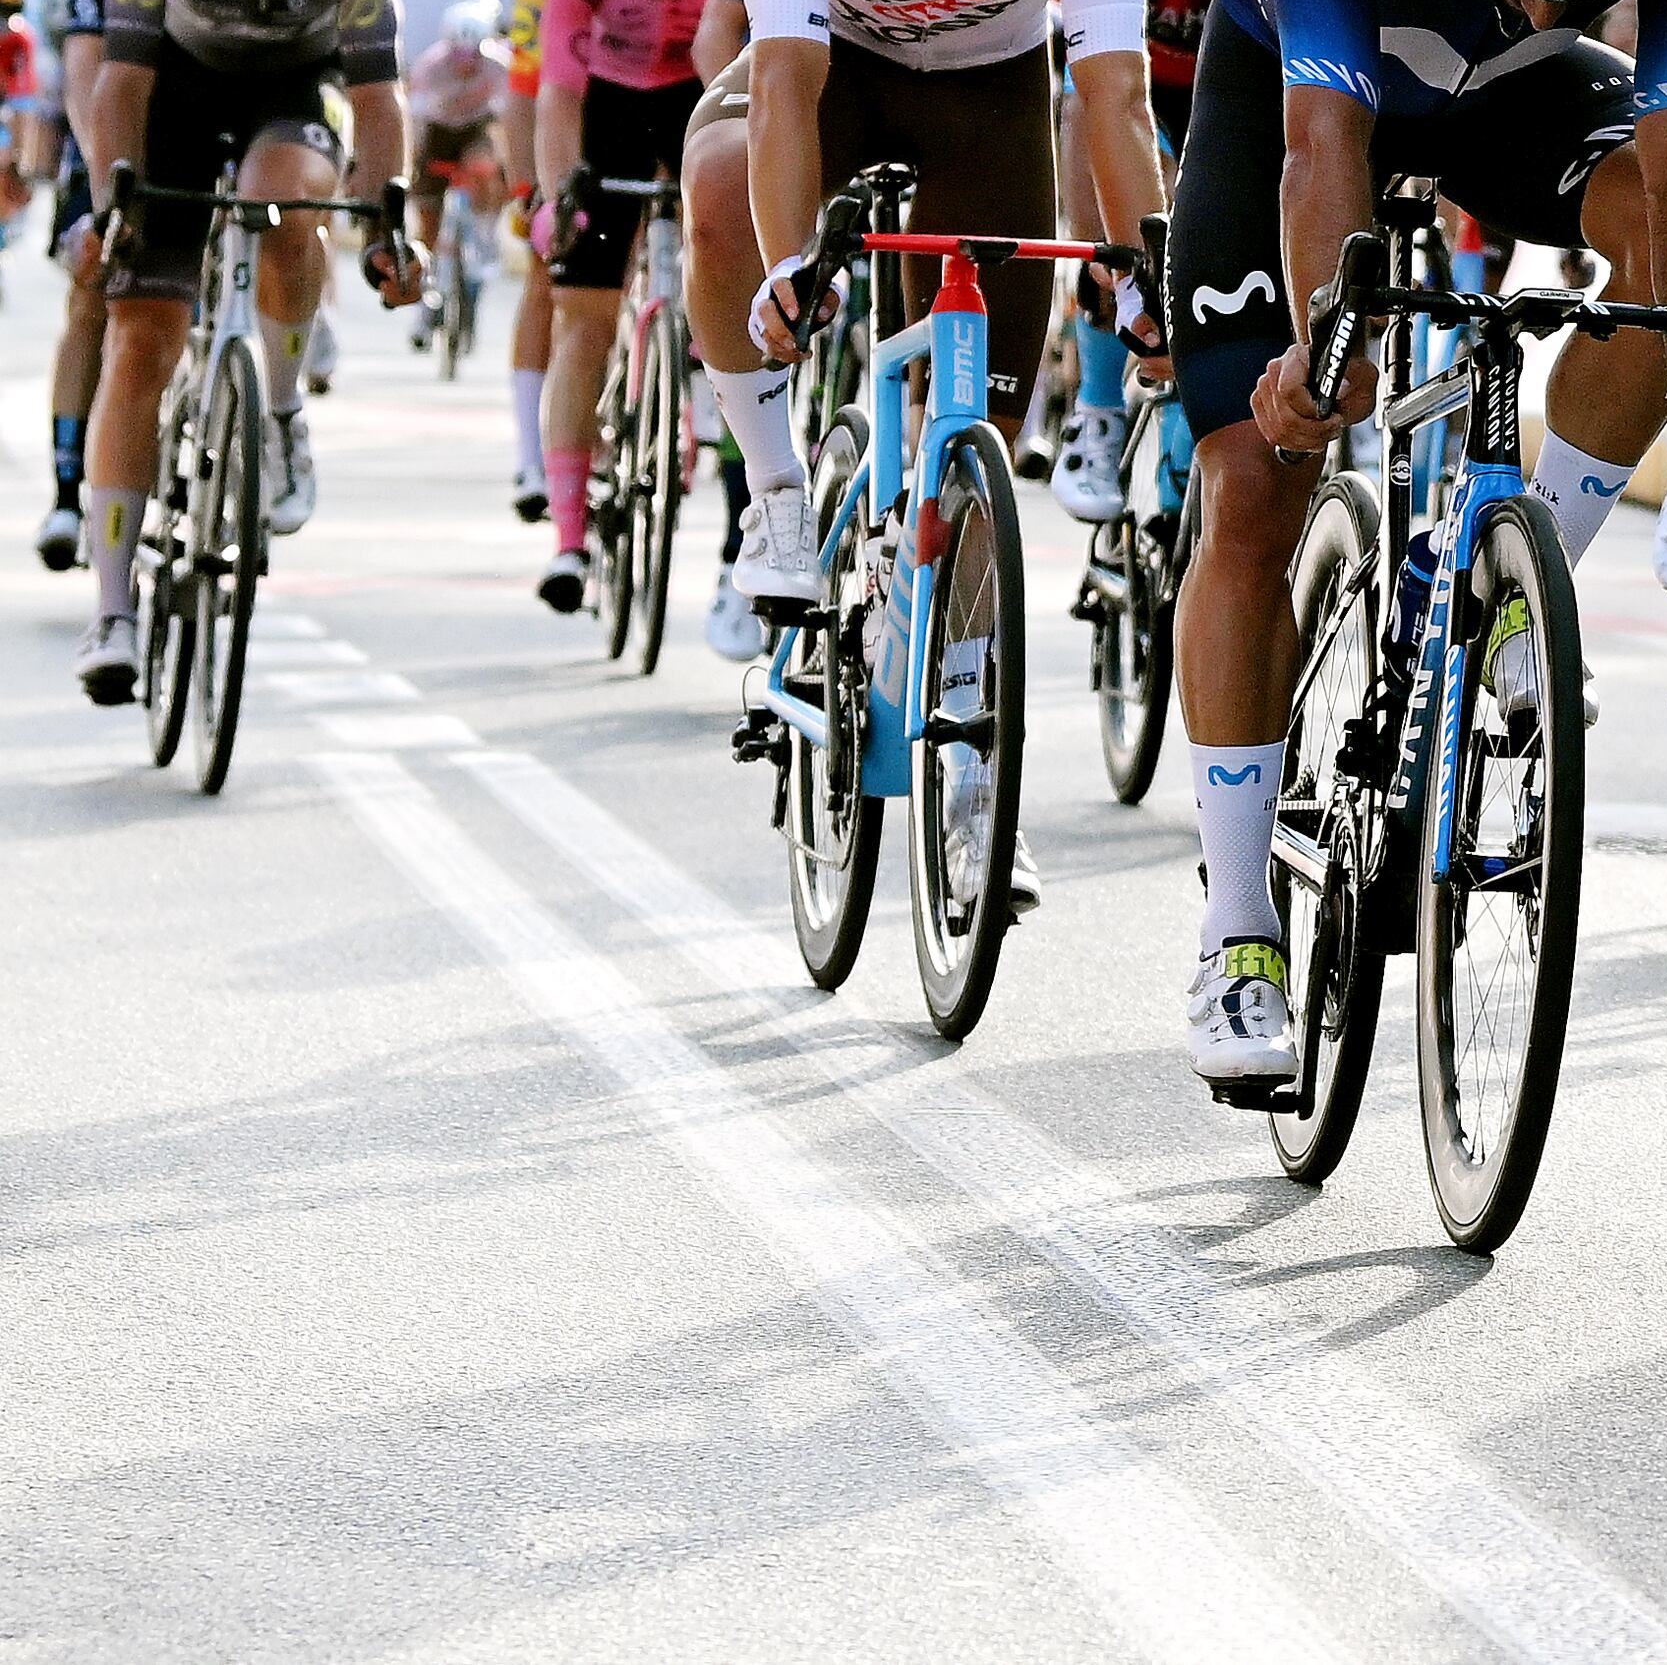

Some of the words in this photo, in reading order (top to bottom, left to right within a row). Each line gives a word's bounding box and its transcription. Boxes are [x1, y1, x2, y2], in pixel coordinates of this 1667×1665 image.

[1539, 291, 1570, 299] GARMIN
[953, 320, 975, 407] BMC
[1489, 366, 1502, 451] CANYON
[1505, 368, 1516, 451] CANYON
